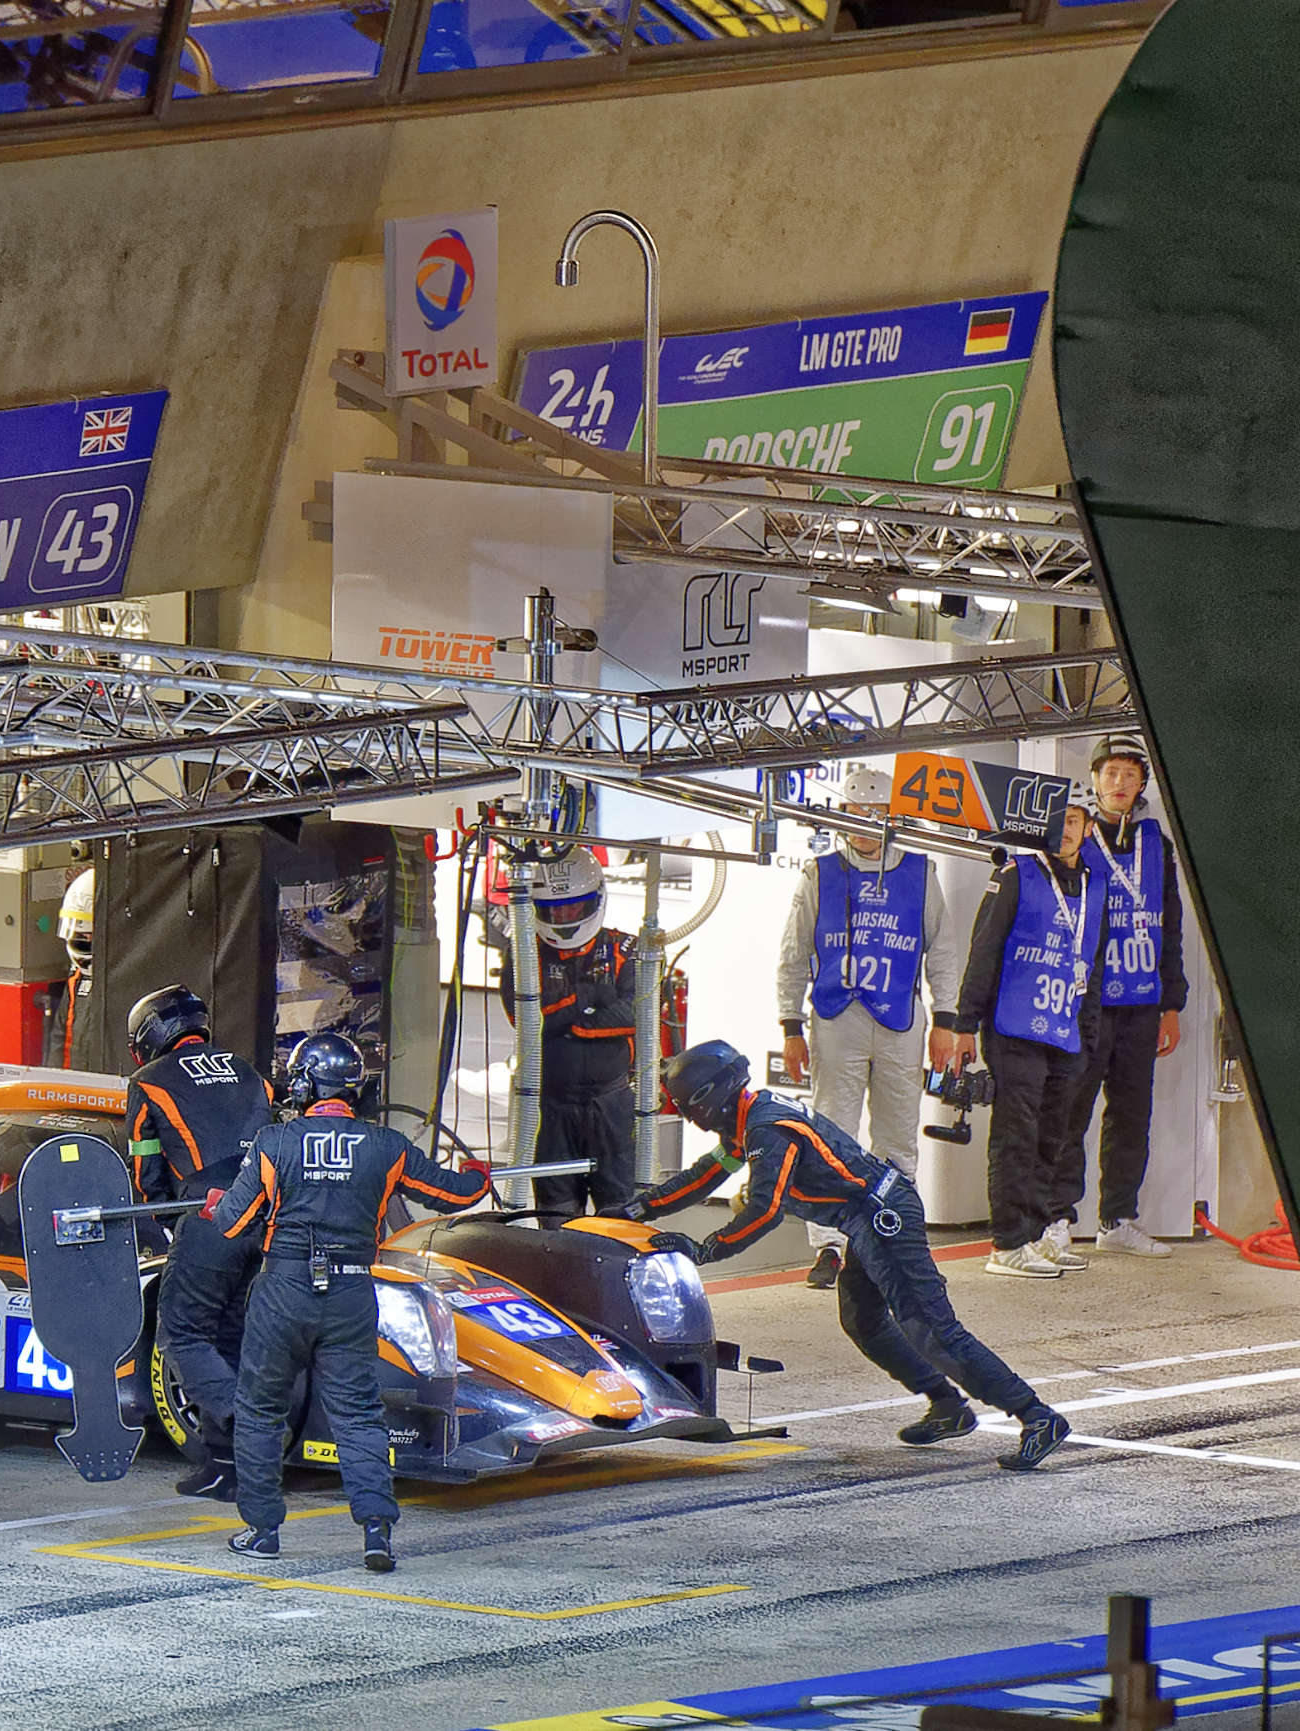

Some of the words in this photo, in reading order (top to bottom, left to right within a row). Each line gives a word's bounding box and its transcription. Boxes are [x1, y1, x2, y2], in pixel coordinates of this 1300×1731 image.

[401, 348, 489, 379] TOTAL
[800, 334, 830, 372] LM
[830, 328, 867, 368] GTE
[867, 325, 902, 365] PRO
[933, 402, 996, 472] 91
[45, 503, 119, 575] 43
[378, 626, 496, 666] TOWER
[682, 653, 751, 678] MSPORT
[900, 764, 965, 817] 43
[1002, 819, 1048, 837] MSPORT
[846, 911, 900, 931] ARSHAL
[825, 928, 871, 948] PITLNE
[883, 931, 918, 952] TRACK
[1045, 932, 1061, 949] RH
[1105, 937, 1157, 974] 400
[1014, 946, 1063, 969] PITLANE
[840, 954, 892, 994] 921
[194, 1076, 240, 1087] MSPORT
[303, 1170, 353, 1181] MSPORT
[486, 1302, 562, 1337] 43
